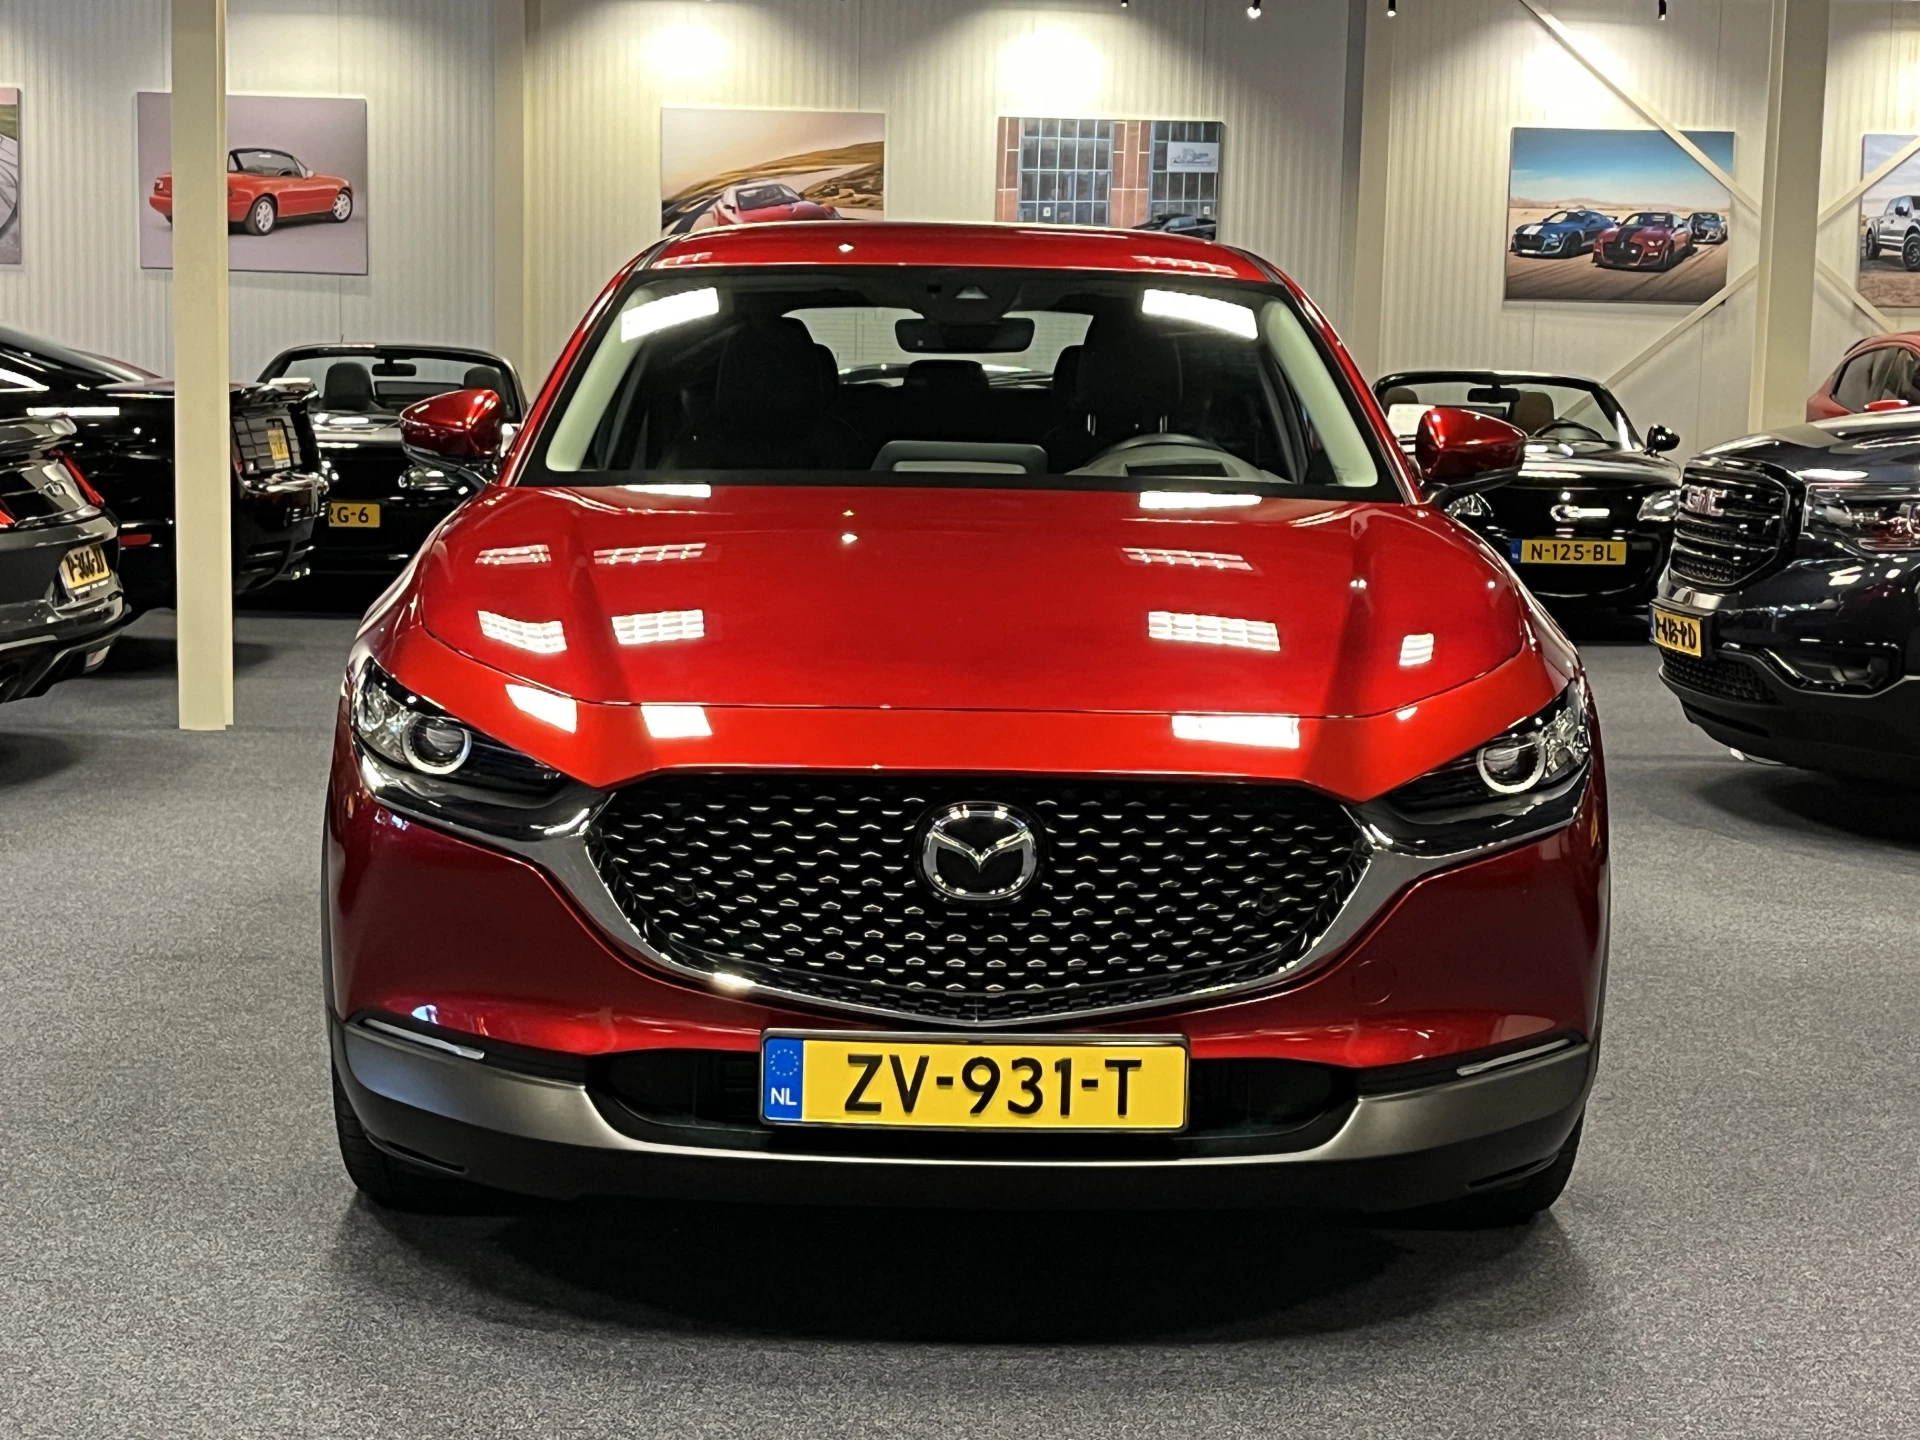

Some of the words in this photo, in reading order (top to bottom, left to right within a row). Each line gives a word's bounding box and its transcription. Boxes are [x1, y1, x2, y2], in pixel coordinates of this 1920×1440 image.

[1531, 543, 1616, 561] N-125-BL
[845, 1053, 1142, 1117] ZV-931-T
[770, 1087, 797, 1106] NL
